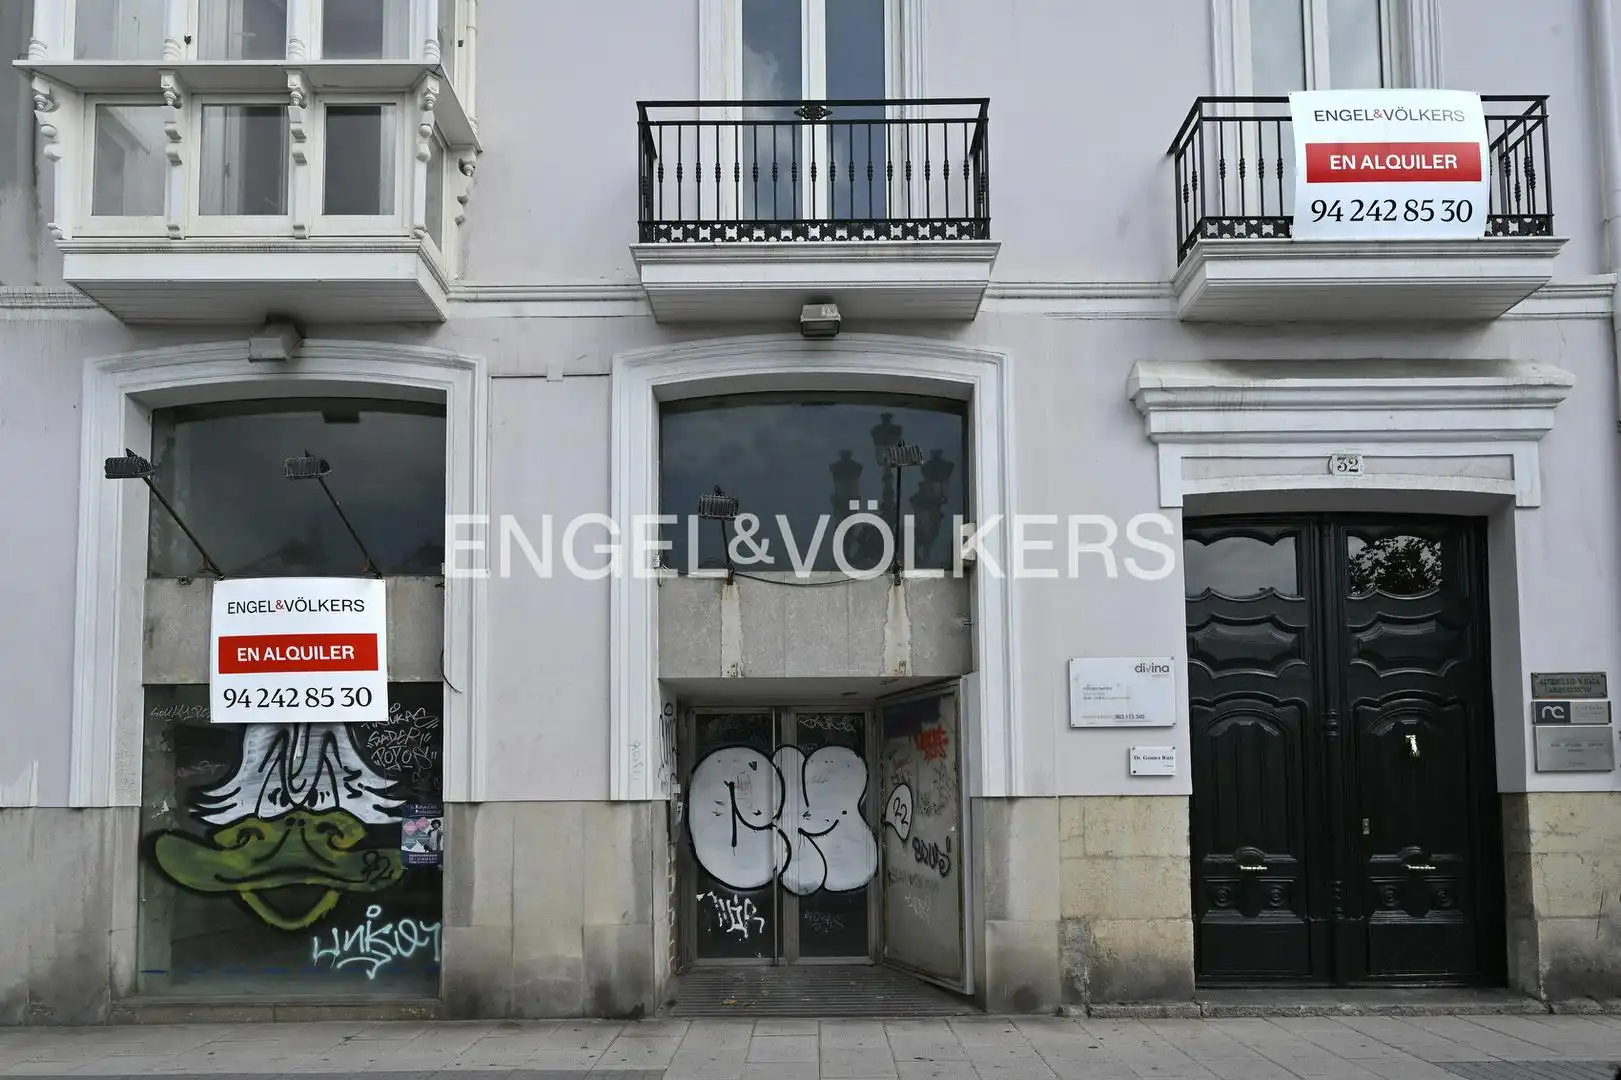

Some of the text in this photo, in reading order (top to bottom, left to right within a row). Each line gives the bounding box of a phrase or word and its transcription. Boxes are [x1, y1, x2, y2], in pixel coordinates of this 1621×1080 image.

[1314, 106, 1465, 122] ENGEL&VÖLKERS
[1330, 154, 1458, 170] EN ALQUILER
[1310, 199, 1473, 222] 94 242 85 30
[1337, 457, 1358, 472] 32
[227, 597, 365, 614] ENGEL&VÖLKERS
[237, 645, 355, 662] EN ALQUILER
[1134, 662, 1170, 673] divina
[223, 686, 372, 708] 94 242 85 30
